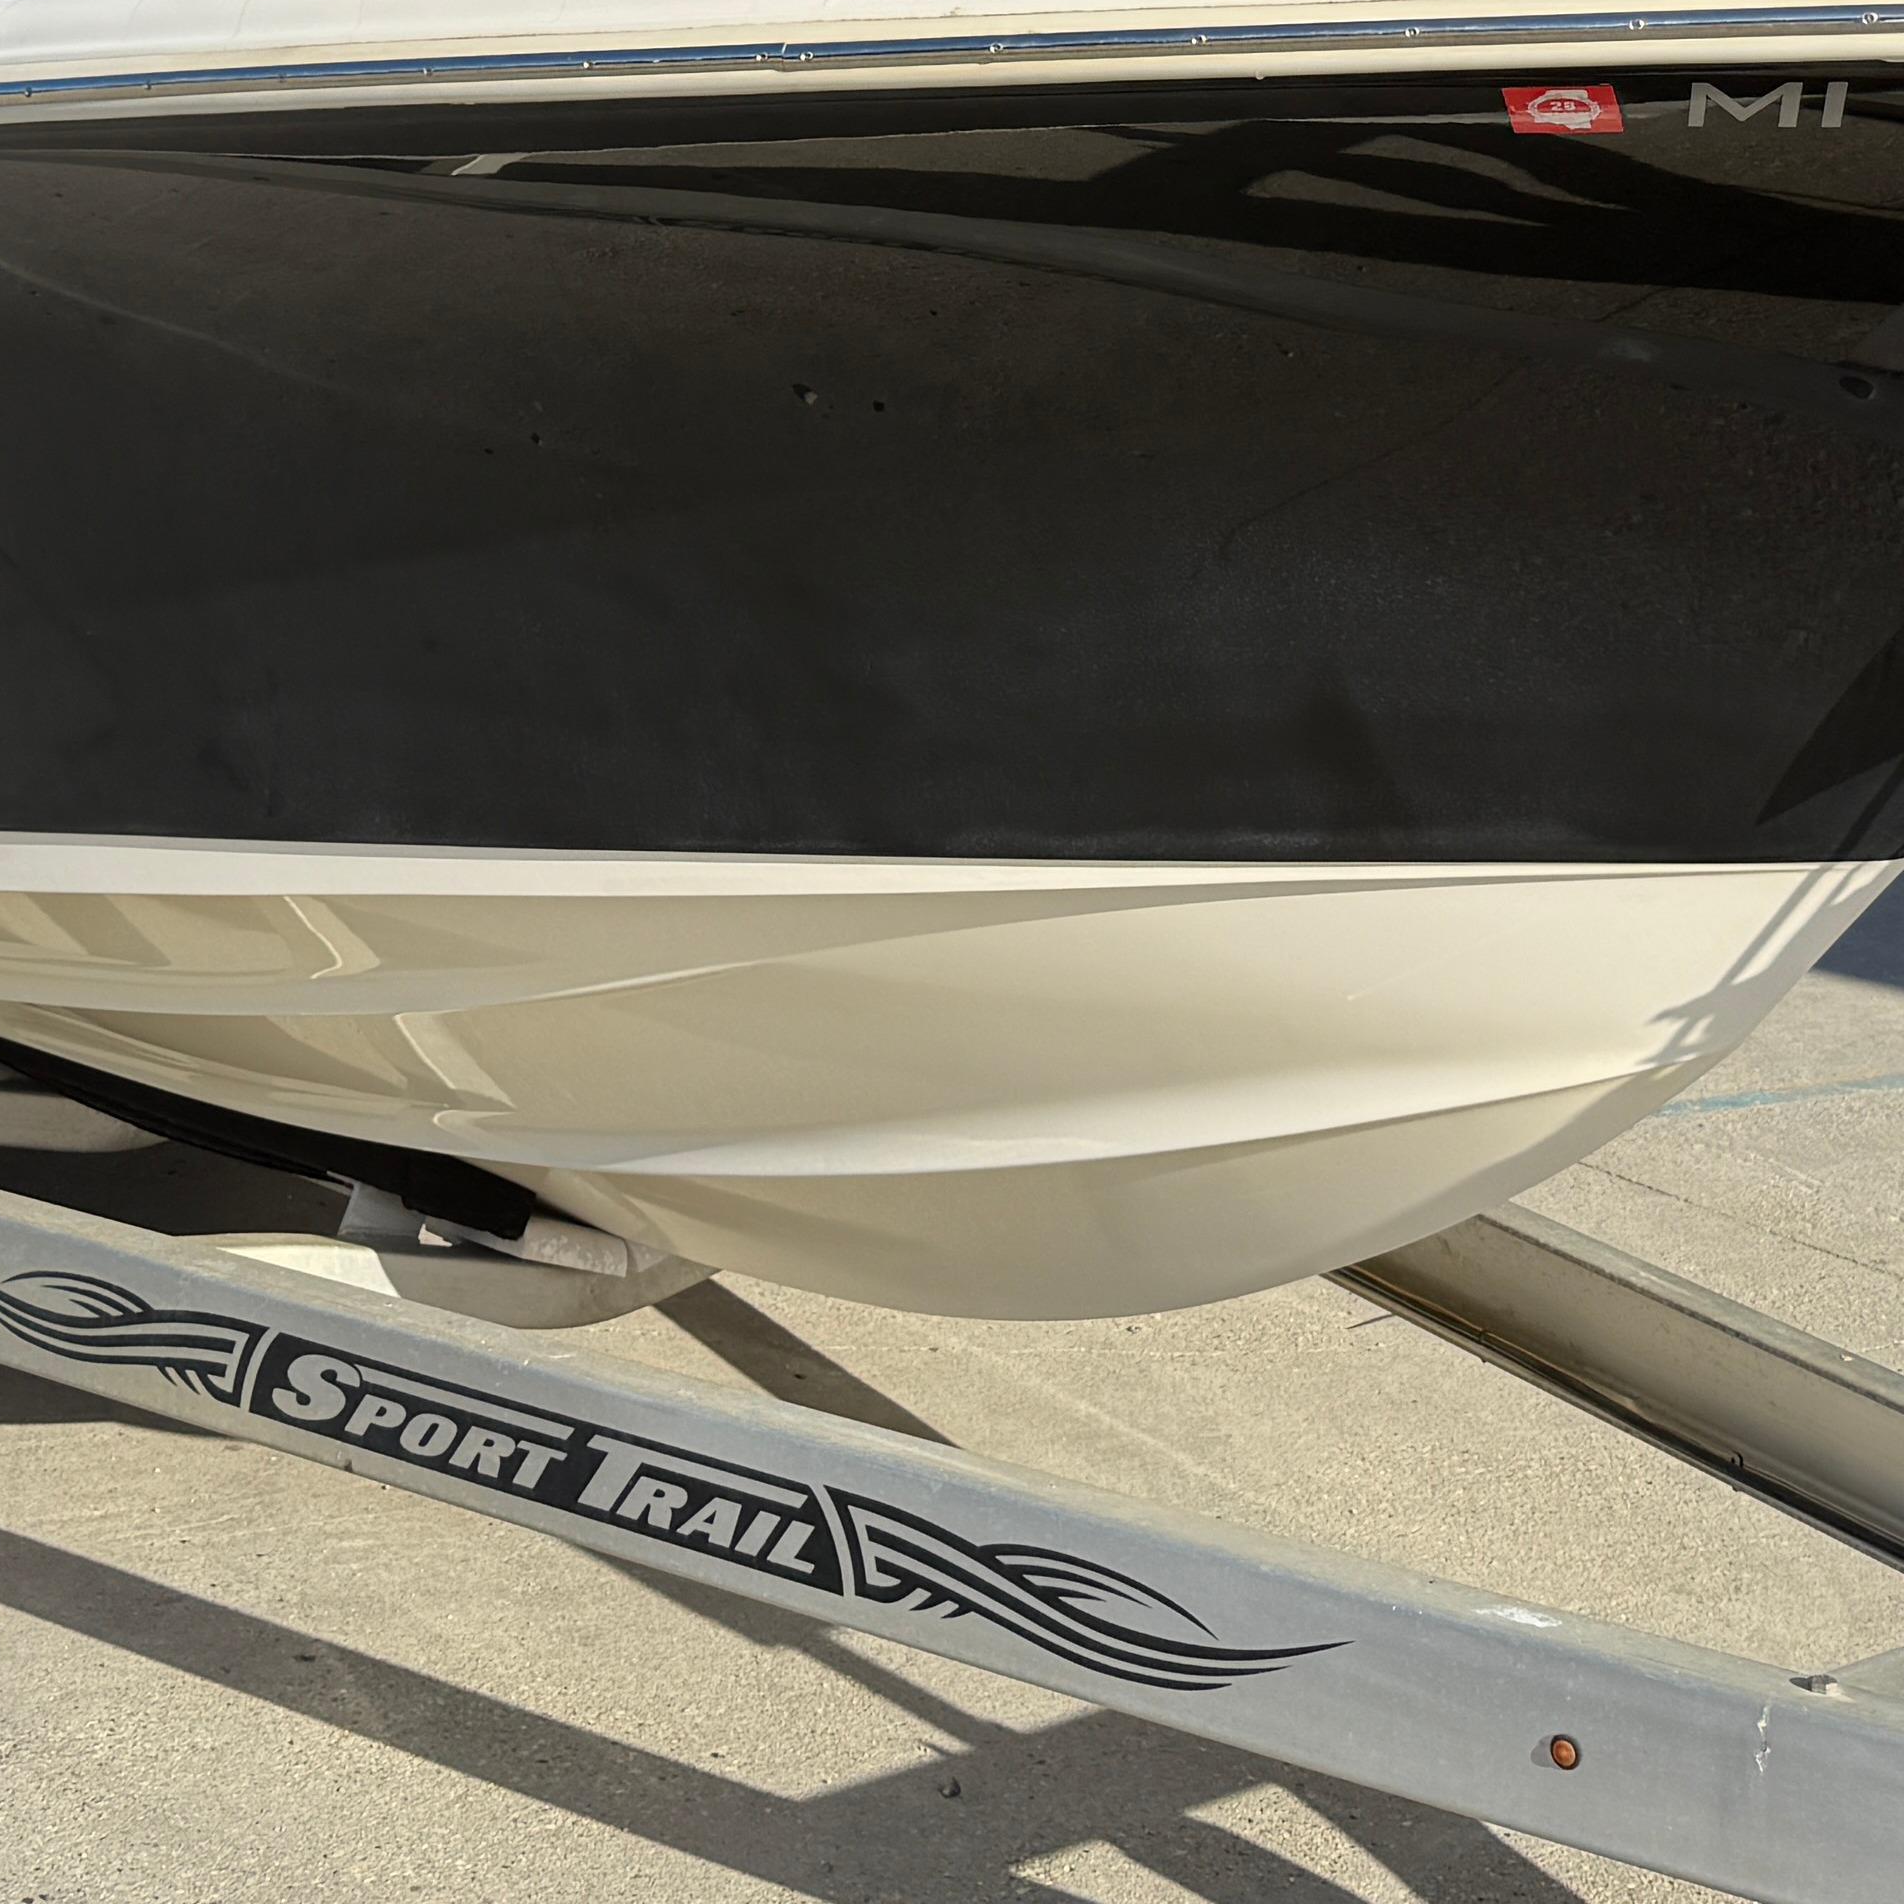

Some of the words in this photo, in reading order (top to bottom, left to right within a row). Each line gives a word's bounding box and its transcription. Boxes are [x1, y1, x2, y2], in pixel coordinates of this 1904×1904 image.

[1688, 81, 1848, 127] MI
[272, 1353, 575, 1489] SPORT
[575, 1433, 817, 1574] TRAIL
